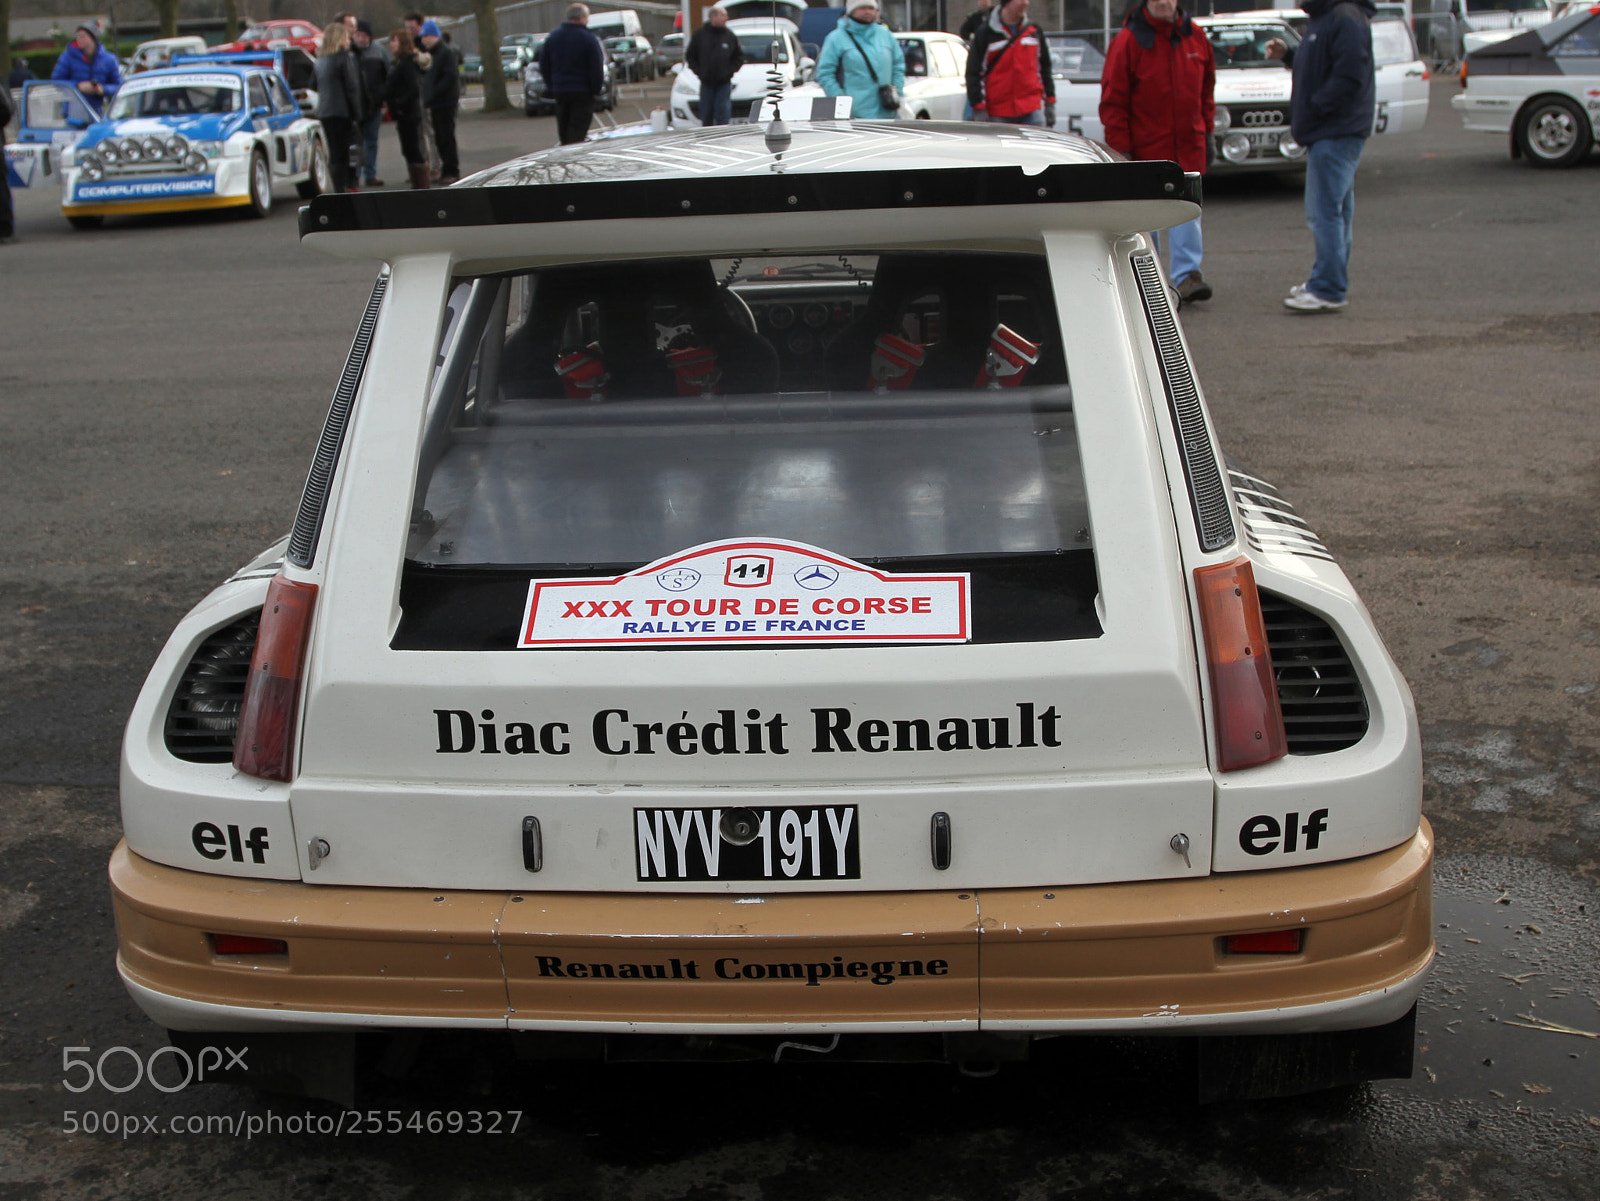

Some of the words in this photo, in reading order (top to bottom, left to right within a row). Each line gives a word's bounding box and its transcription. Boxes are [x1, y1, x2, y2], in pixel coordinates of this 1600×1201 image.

[78, 180, 213, 198] COMPUTERVISION
[733, 563, 766, 579] 11
[562, 600, 633, 619] XXX
[645, 598, 741, 617] TOUR
[754, 598, 799, 616] DE
[812, 596, 932, 615] CORSE
[622, 620, 716, 634] RALLYE
[725, 620, 757, 632] DE
[765, 619, 866, 632] FRANCE
[432, 708, 571, 756] Diac
[592, 708, 790, 757] Crédit
[810, 702, 1062, 753] Renault
[191, 821, 270, 865] elf
[636, 809, 723, 878] NYV
[755, 807, 855, 878] 191Y
[1238, 807, 1329, 856] elf
[534, 955, 701, 980] Renault
[713, 955, 949, 987] Compiegne
